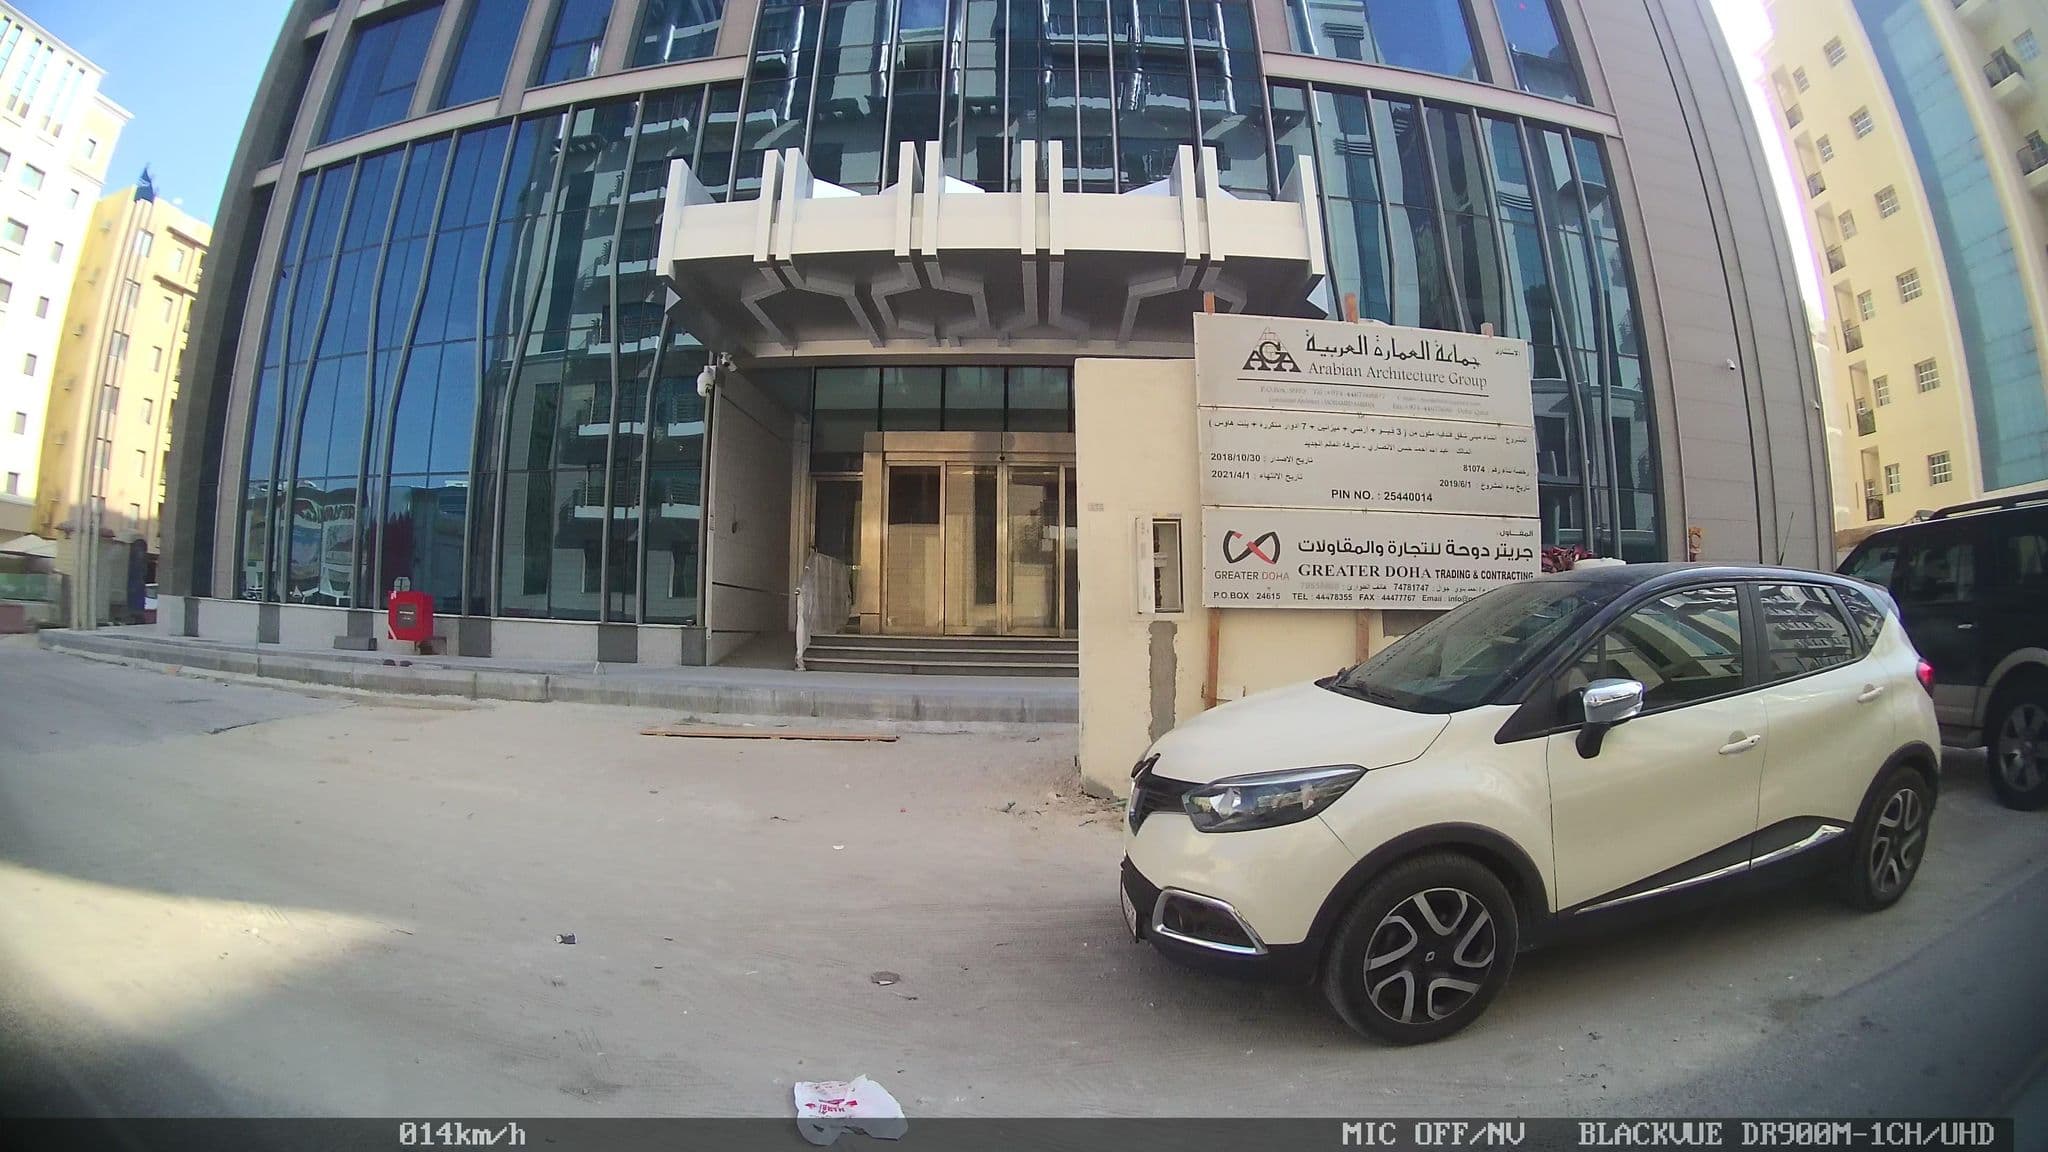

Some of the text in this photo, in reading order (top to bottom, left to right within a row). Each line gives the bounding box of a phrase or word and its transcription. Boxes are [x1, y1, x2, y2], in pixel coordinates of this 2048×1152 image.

[1305, 329, 1481, 369] جماعة العمارة العربية
[1308, 362, 1488, 390] Arabian Architecture Group
[1211, 453, 1261, 462] 2018/10/30
[1211, 470, 1250, 479] 2021/4/1
[1439, 479, 1471, 488] 2019/6/1
[1331, 489, 1350, 499] PIN
[1354, 490, 1374, 500] NO.
[1384, 491, 1433, 502] 25440014
[1298, 538, 1534, 562] جريتر دوحة للتجارة والمقاولات
[1214, 570, 1290, 581] GREATER DOHA
[1298, 563, 1534, 581] GREATER DOHA TRADING & CONTRACTING
[1393, 583, 1430, 592] 74781747
[1256, 592, 1281, 600] 24615
[1359, 593, 1375, 601] FAX
